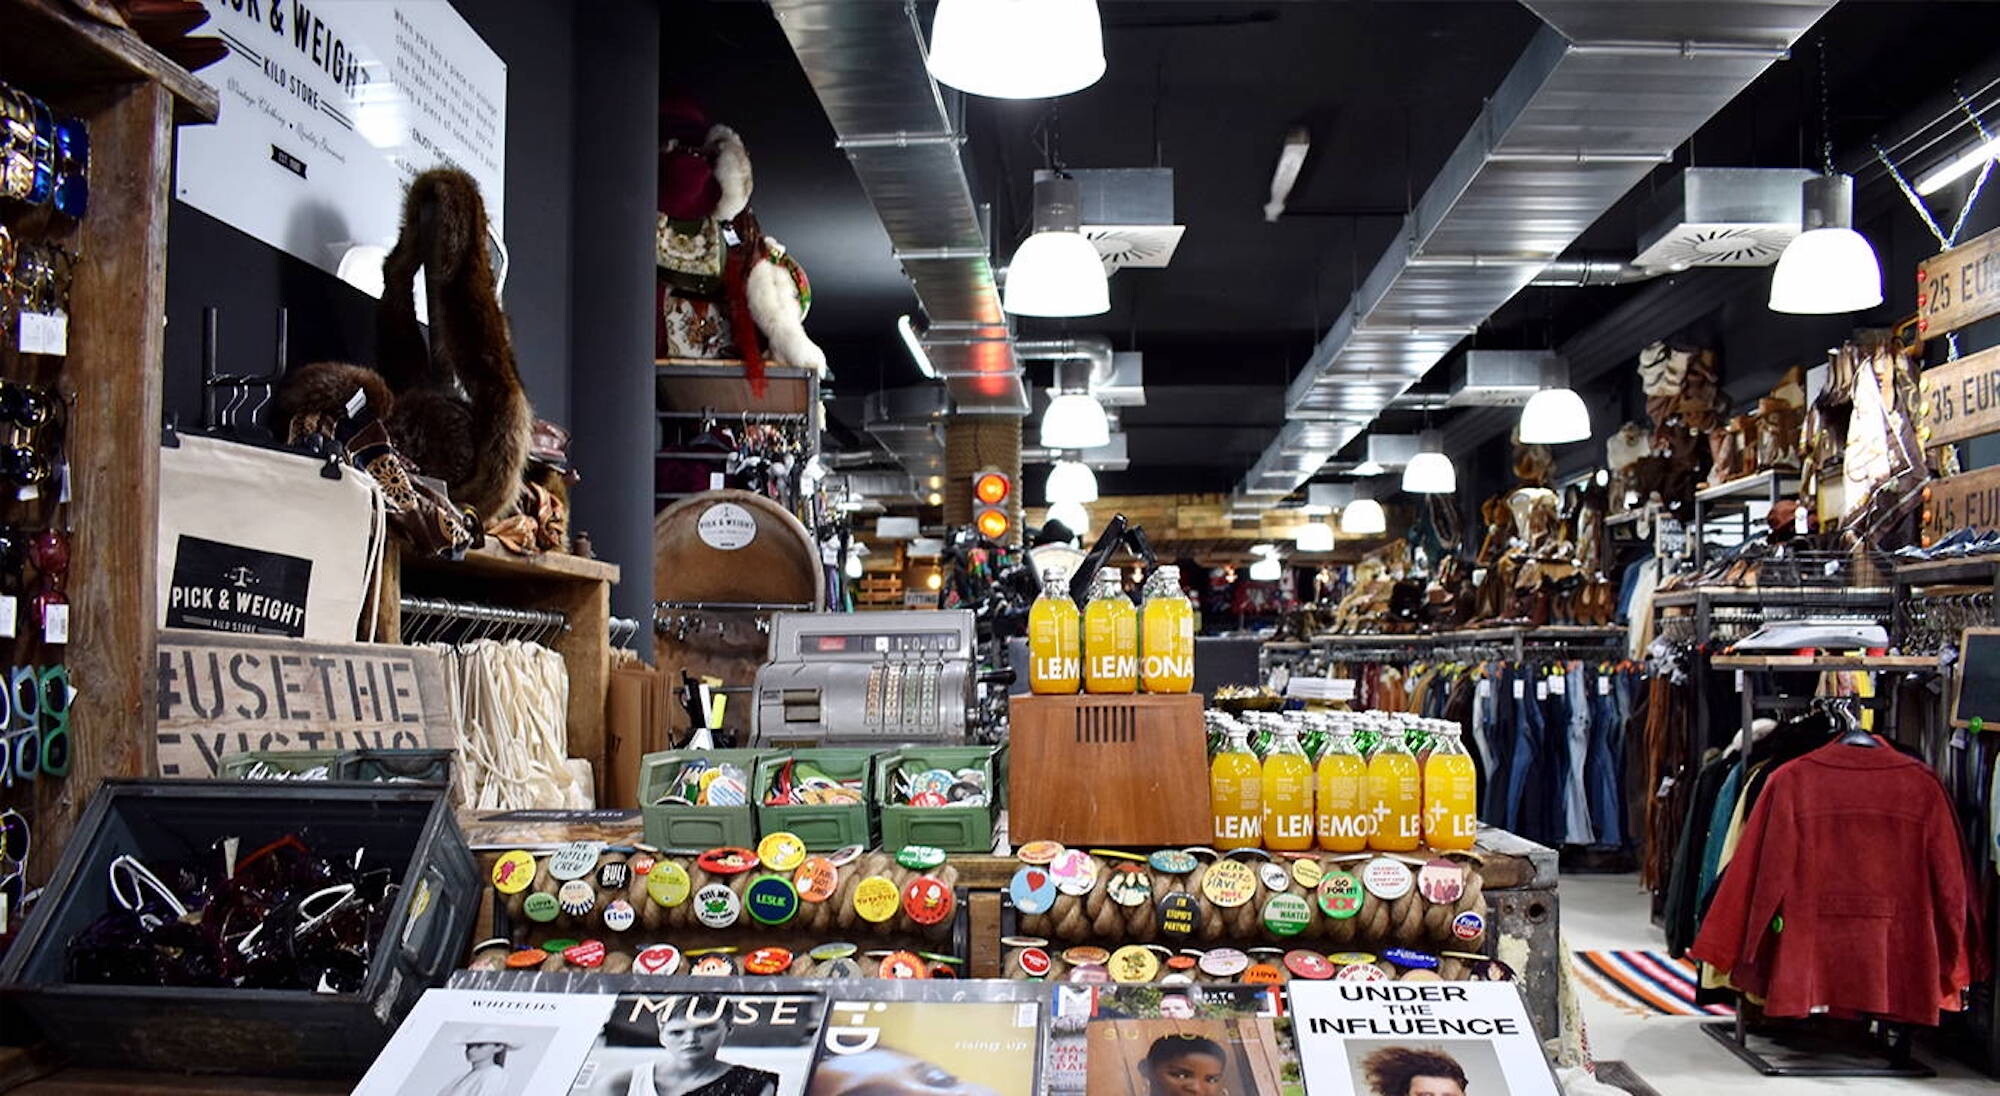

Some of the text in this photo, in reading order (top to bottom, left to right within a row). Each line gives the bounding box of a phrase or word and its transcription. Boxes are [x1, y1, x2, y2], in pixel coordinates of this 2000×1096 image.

[264, 57, 318, 110] KILO STORE
[1930, 272, 1951, 315] 25
[1932, 386, 1953, 425] 35
[172, 586, 304, 628] PICK & WEIGHT
[1280, 911, 1309, 920] WANTED
[1340, 985, 1469, 1001] UNDER
[628, 996, 799, 1026] MUSE
[1383, 1004, 1433, 1016] THE
[1310, 1018, 1520, 1035] INFLUENCE
